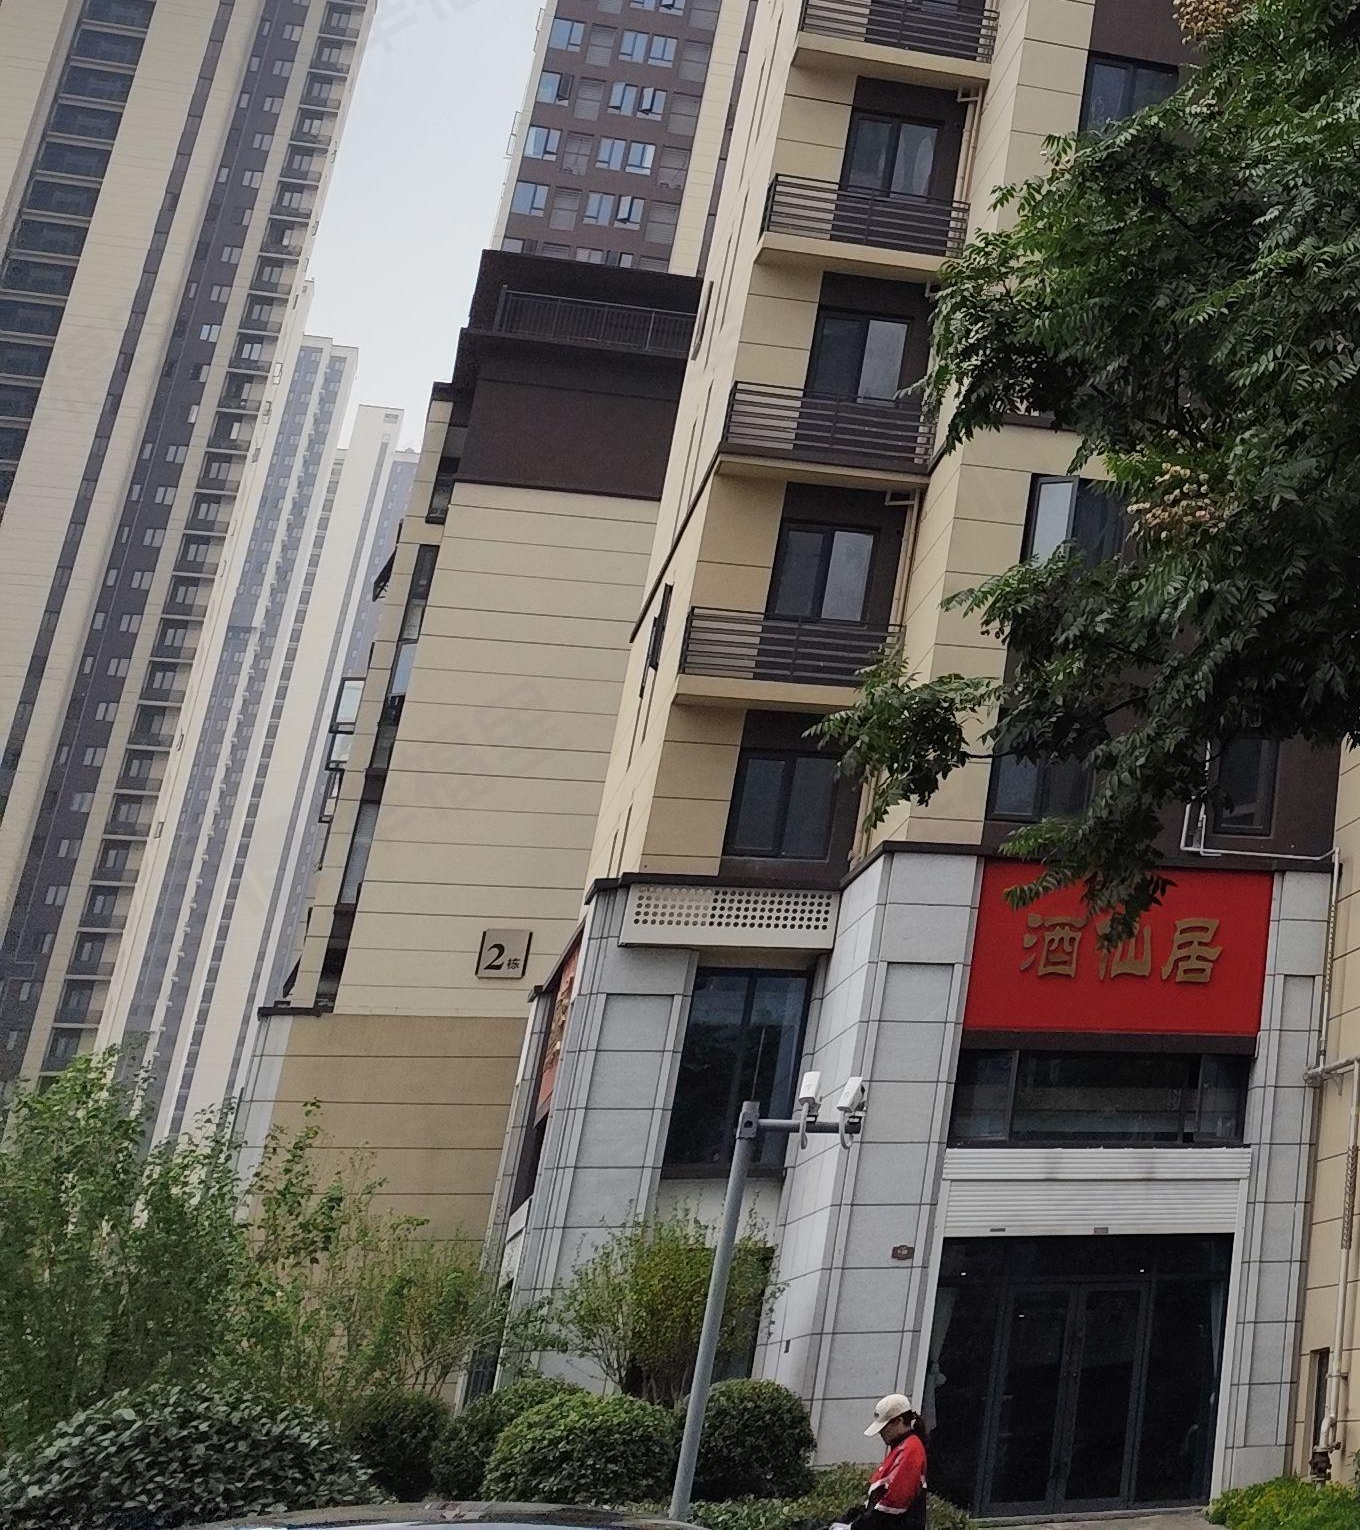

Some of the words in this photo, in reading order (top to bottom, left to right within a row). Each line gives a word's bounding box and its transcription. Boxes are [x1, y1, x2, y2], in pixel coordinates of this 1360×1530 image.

[483, 943, 521, 970] 2栋
[1021, 911, 1223, 984] 酒仙居
